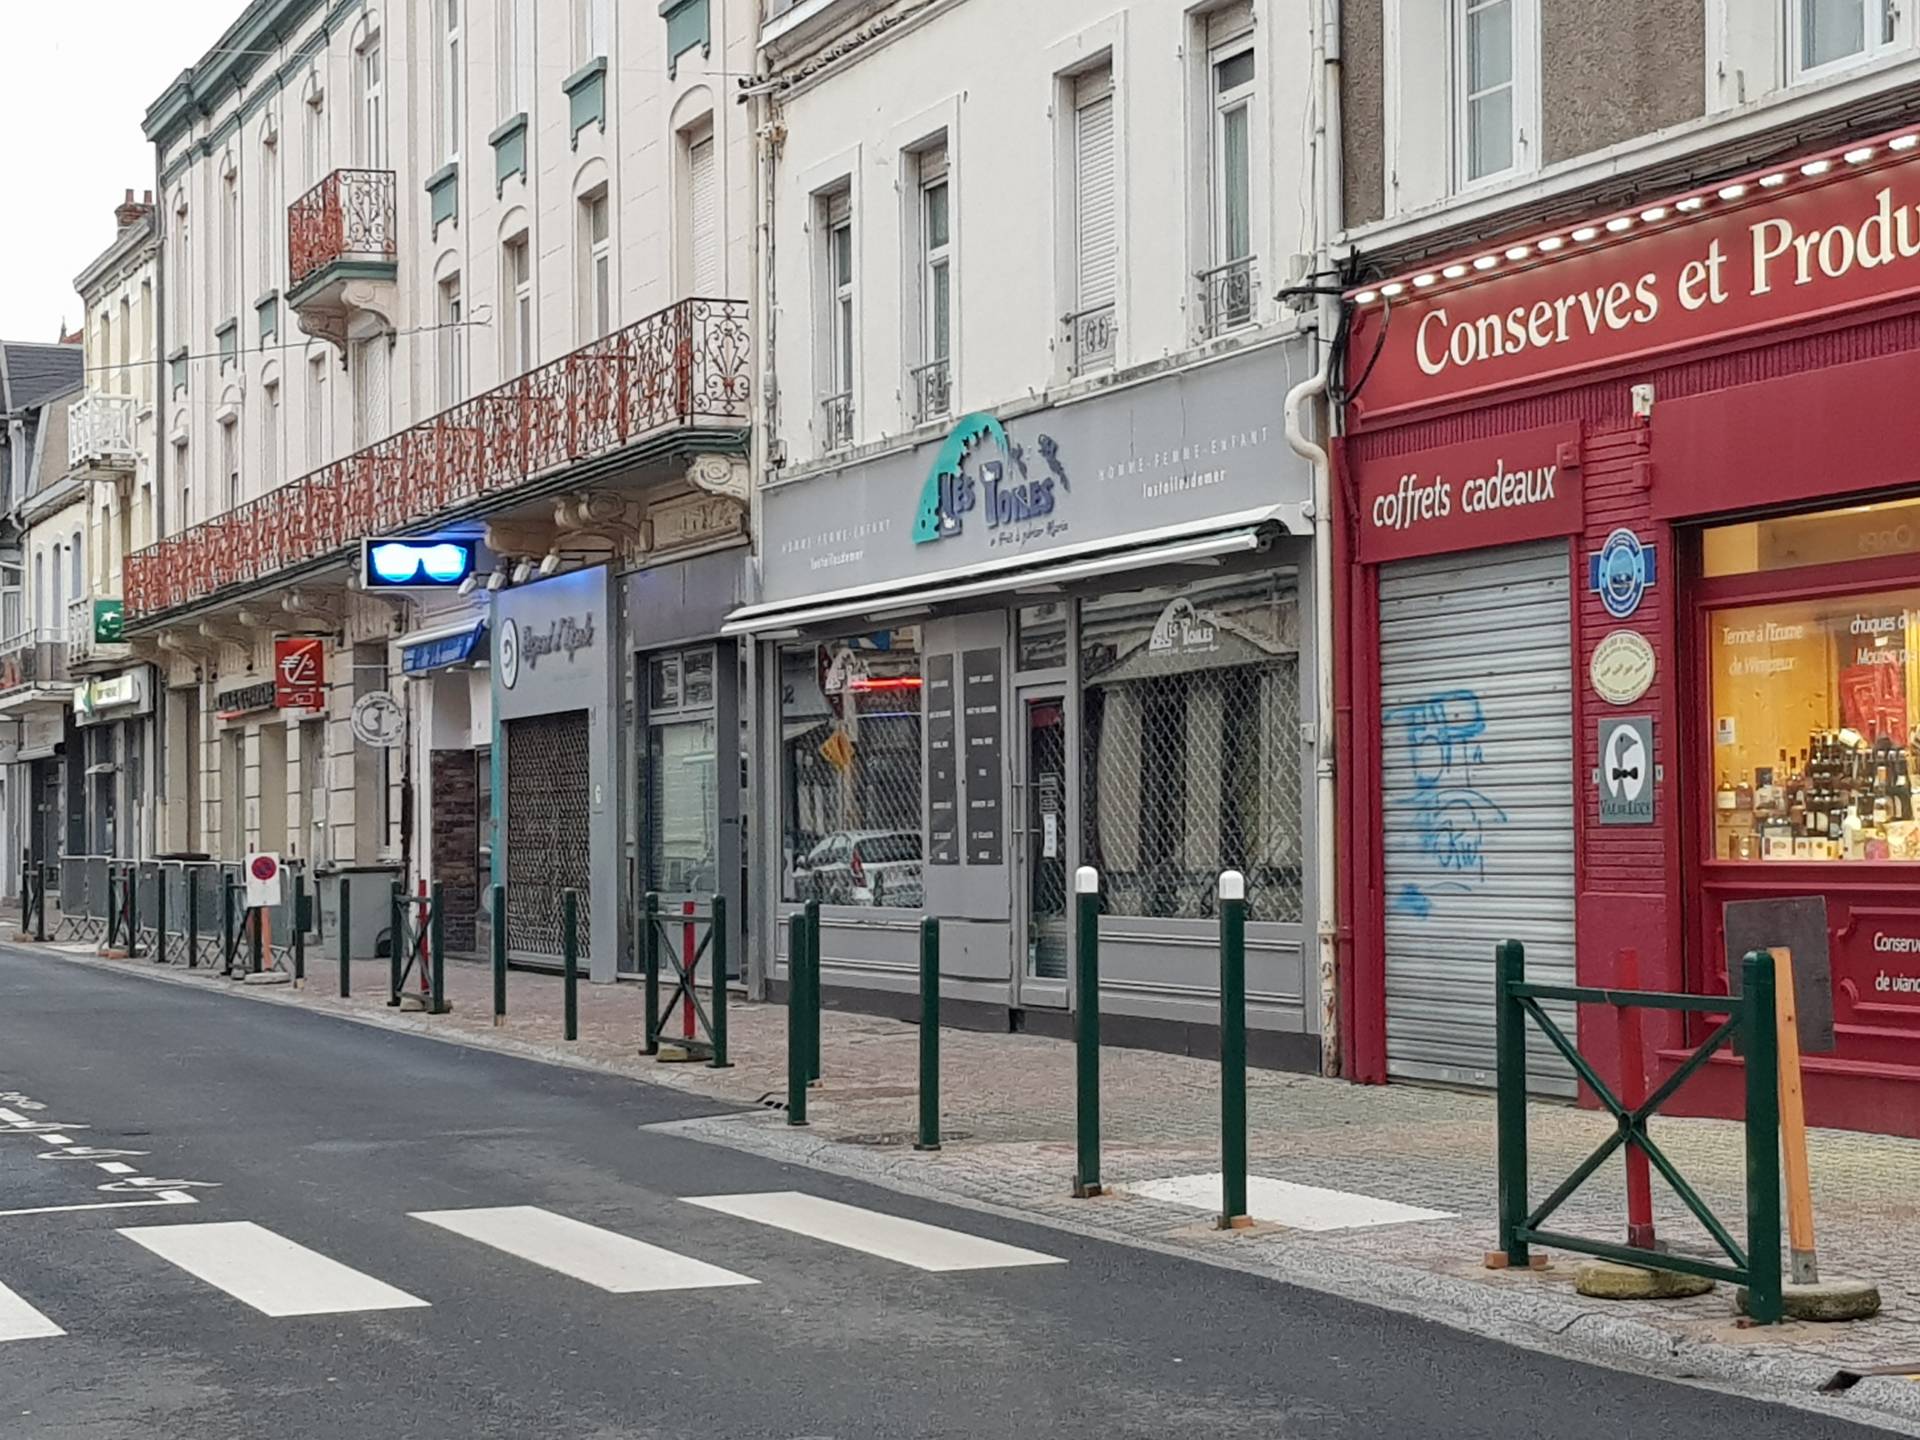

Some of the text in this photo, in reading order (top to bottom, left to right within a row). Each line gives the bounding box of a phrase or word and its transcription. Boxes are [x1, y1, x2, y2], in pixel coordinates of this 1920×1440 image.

[1415, 271, 1658, 375] Conserves
[1678, 239, 1728, 311] et
[1373, 459, 1557, 530] coffrets cadeaux
[1874, 931, 1920, 953] Conserv
[1875, 970, 1890, 991] de
